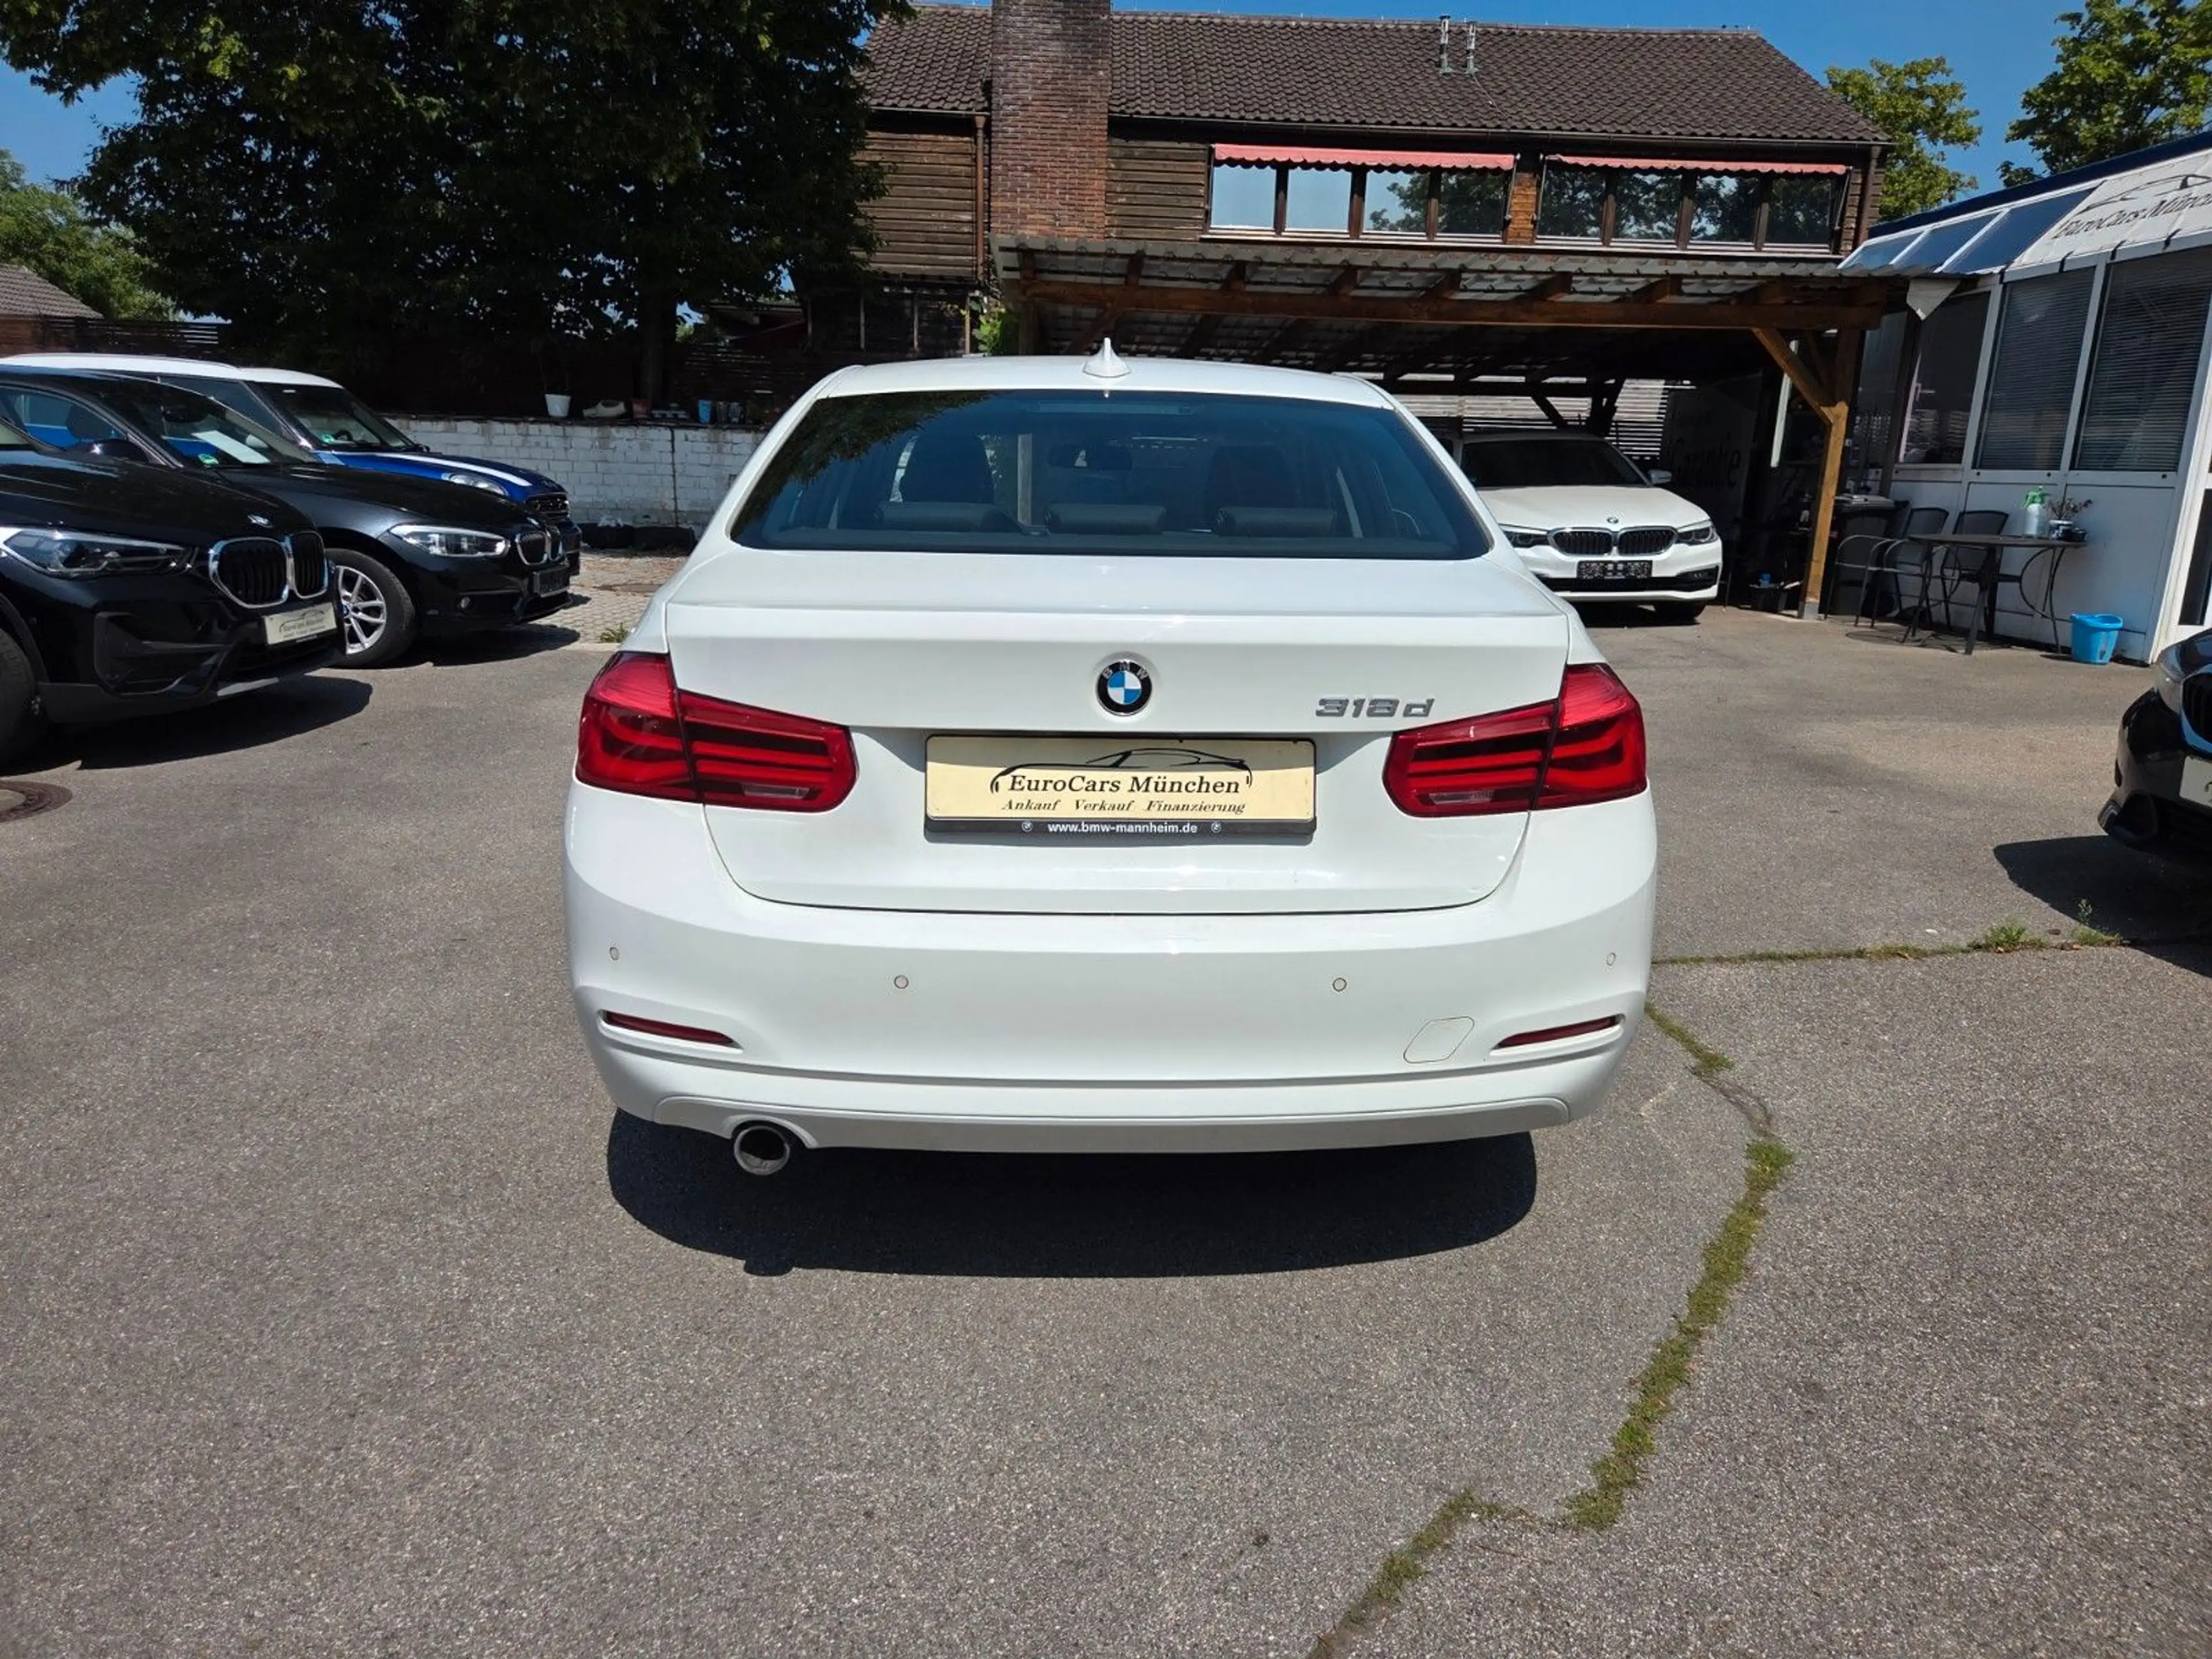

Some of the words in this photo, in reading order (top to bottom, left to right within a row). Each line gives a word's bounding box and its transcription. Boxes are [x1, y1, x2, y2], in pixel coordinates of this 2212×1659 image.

[1101, 660, 1149, 680] BMW
[1316, 698, 1435, 718] 318d
[1008, 775, 1121, 793] EuroCars
[1127, 775, 1240, 794] München
[1002, 799, 1062, 811] Ankauf
[1074, 799, 1135, 812] Verkauf
[1145, 800, 1246, 815] Finanzierung
[1047, 821, 1198, 834] www.bmw-mannheim.de
